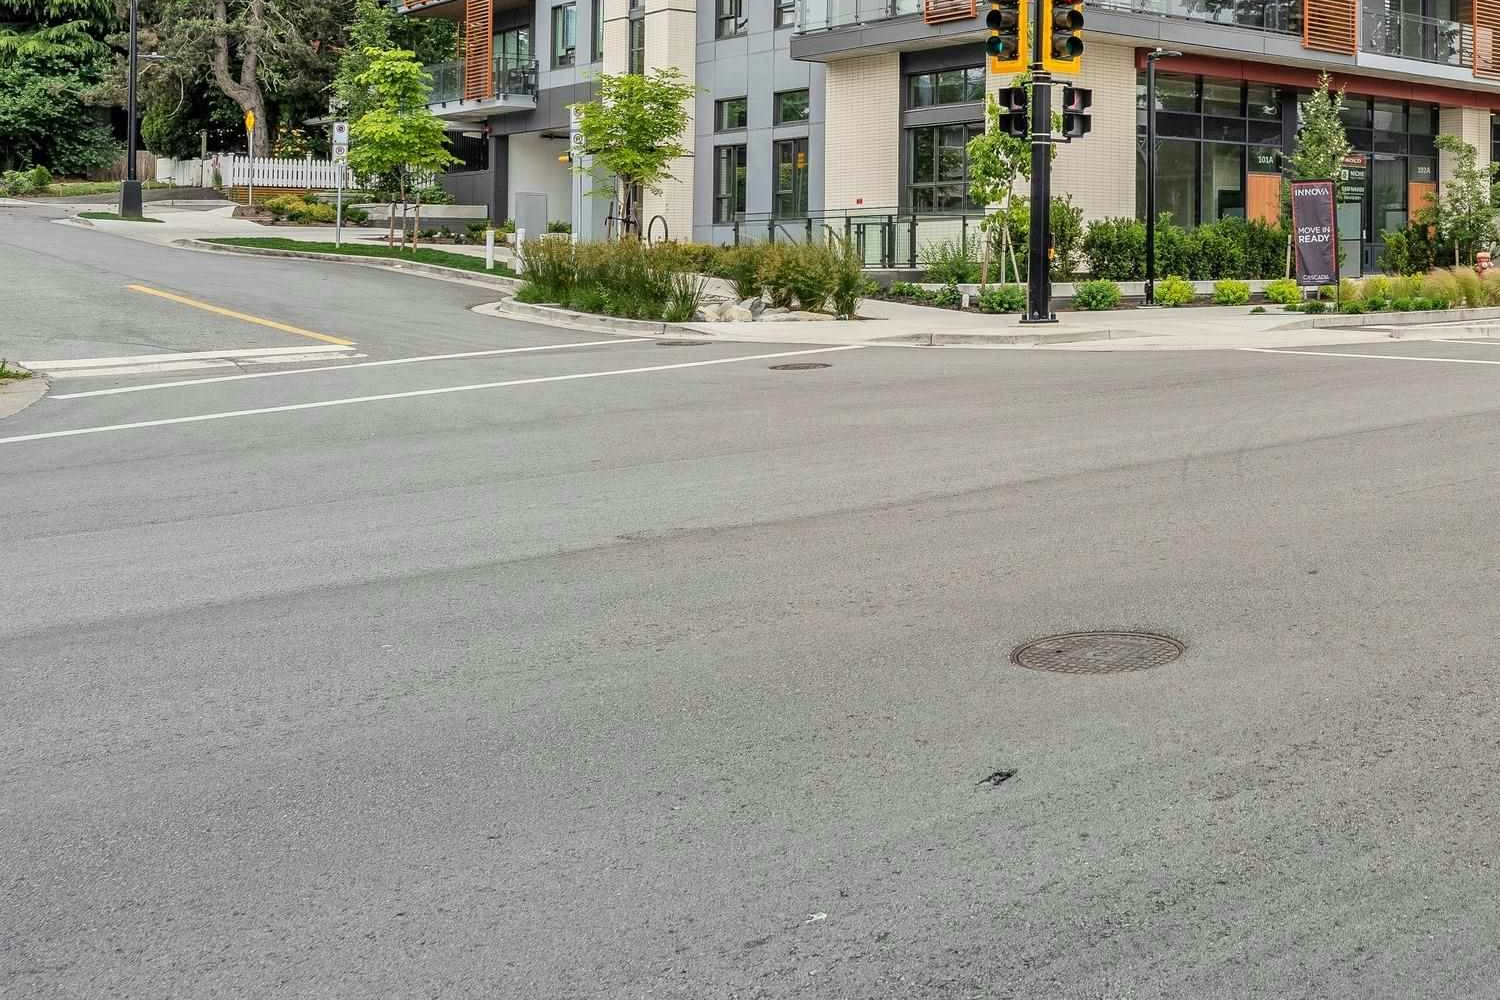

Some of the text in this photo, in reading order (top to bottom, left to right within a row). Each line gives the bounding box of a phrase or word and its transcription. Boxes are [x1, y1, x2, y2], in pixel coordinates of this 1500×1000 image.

[1258, 155, 1274, 164] 101A
[1295, 188, 1329, 196] INNOVA
[1298, 226, 1330, 234] MOVE IN
[1298, 234, 1330, 243] READY
